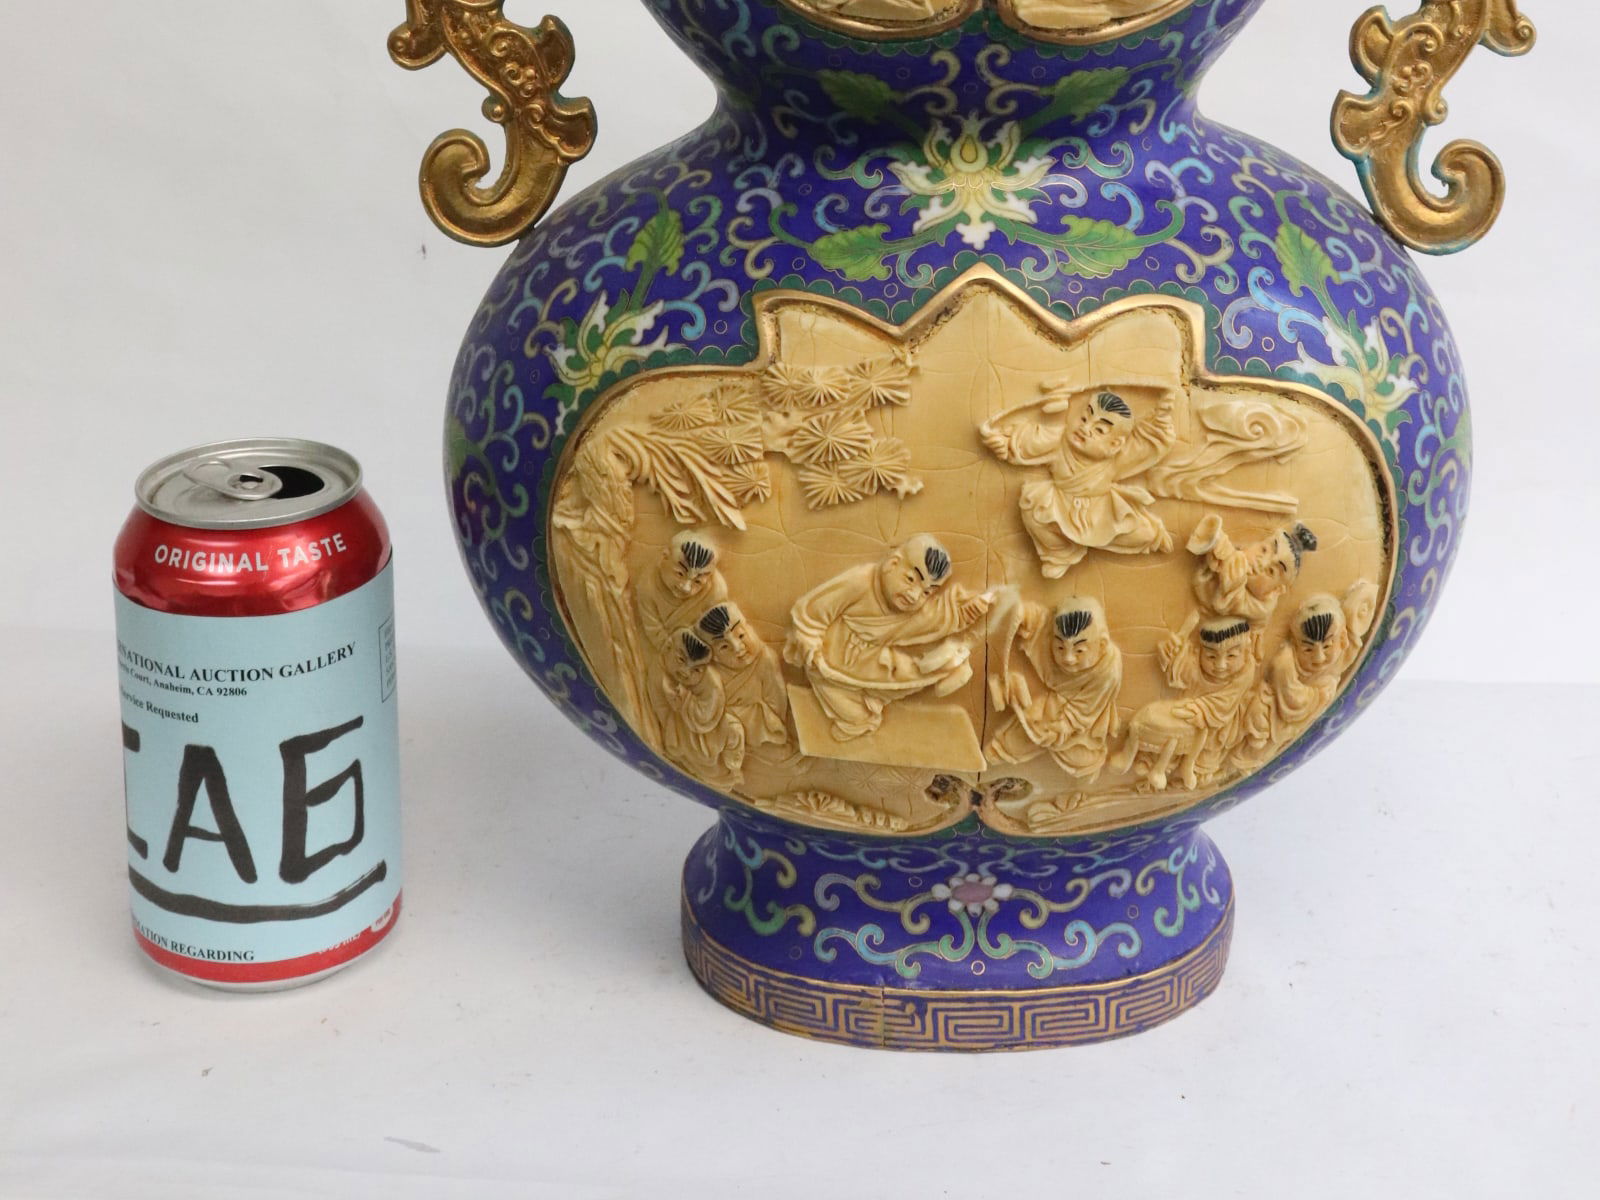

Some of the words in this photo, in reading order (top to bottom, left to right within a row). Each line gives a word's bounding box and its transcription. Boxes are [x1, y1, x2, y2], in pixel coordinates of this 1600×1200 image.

[154, 544, 269, 573] ORIGINAL
[277, 533, 347, 568] TASTE
[190, 667, 273, 682] AUCTION
[279, 641, 356, 678] GALLERY
[153, 679, 195, 695] Anaheim,
[196, 686, 214, 696] CA
[216, 687, 247, 697] 92806
[146, 701, 199, 724] Requested
[170, 940, 255, 962] REGARDING
